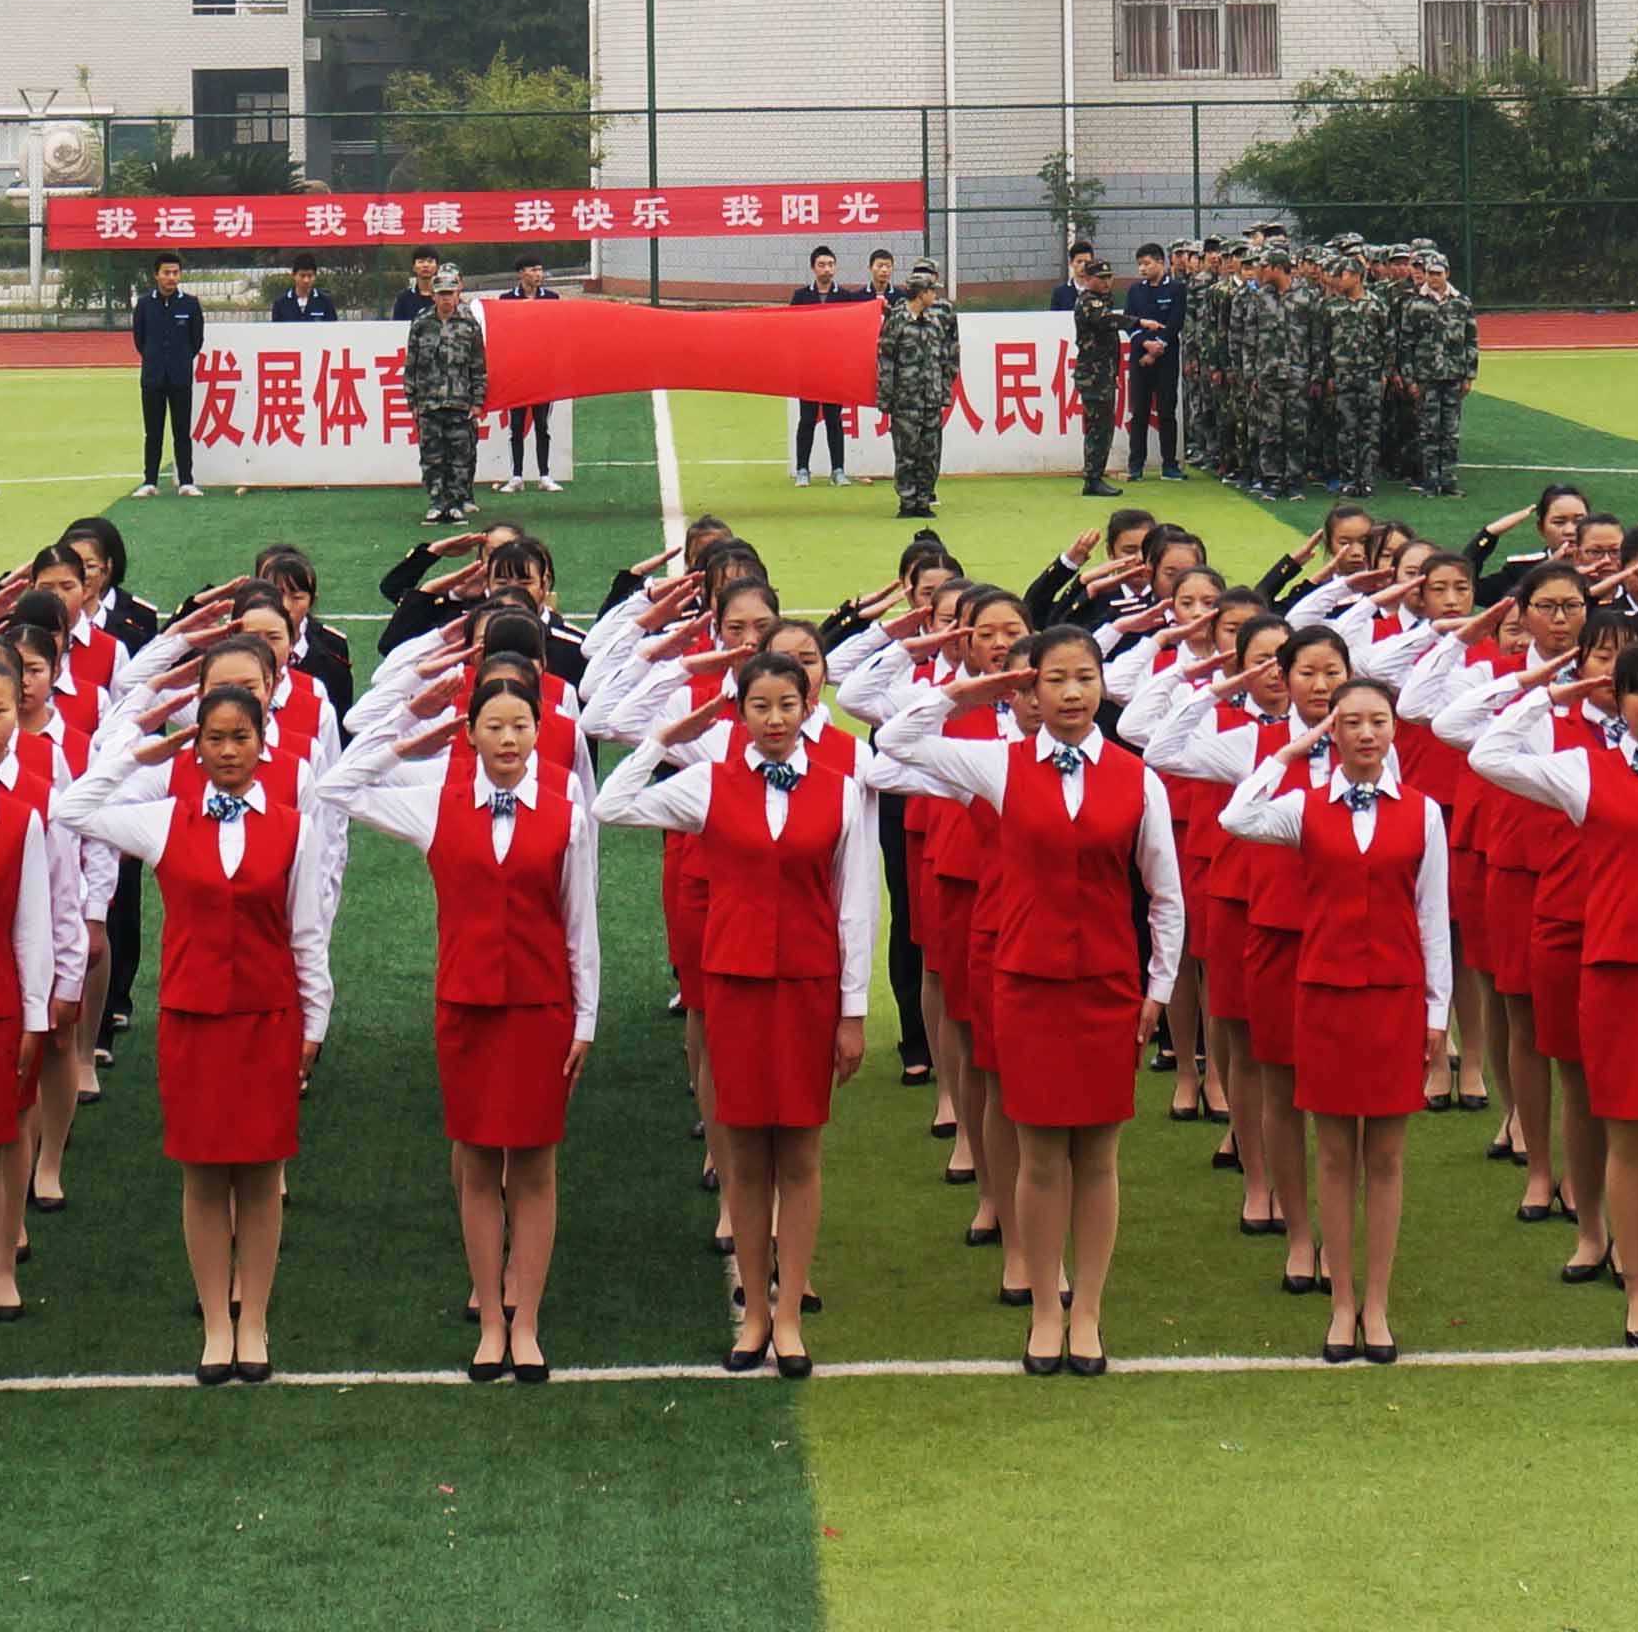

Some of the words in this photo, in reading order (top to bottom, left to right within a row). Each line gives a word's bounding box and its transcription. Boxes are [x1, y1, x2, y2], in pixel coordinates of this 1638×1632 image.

[96, 205, 254, 239] 我运动
[305, 201, 462, 235] 我健康
[514, 197, 671, 232] 我快乐
[722, 191, 881, 227] 我阳光
